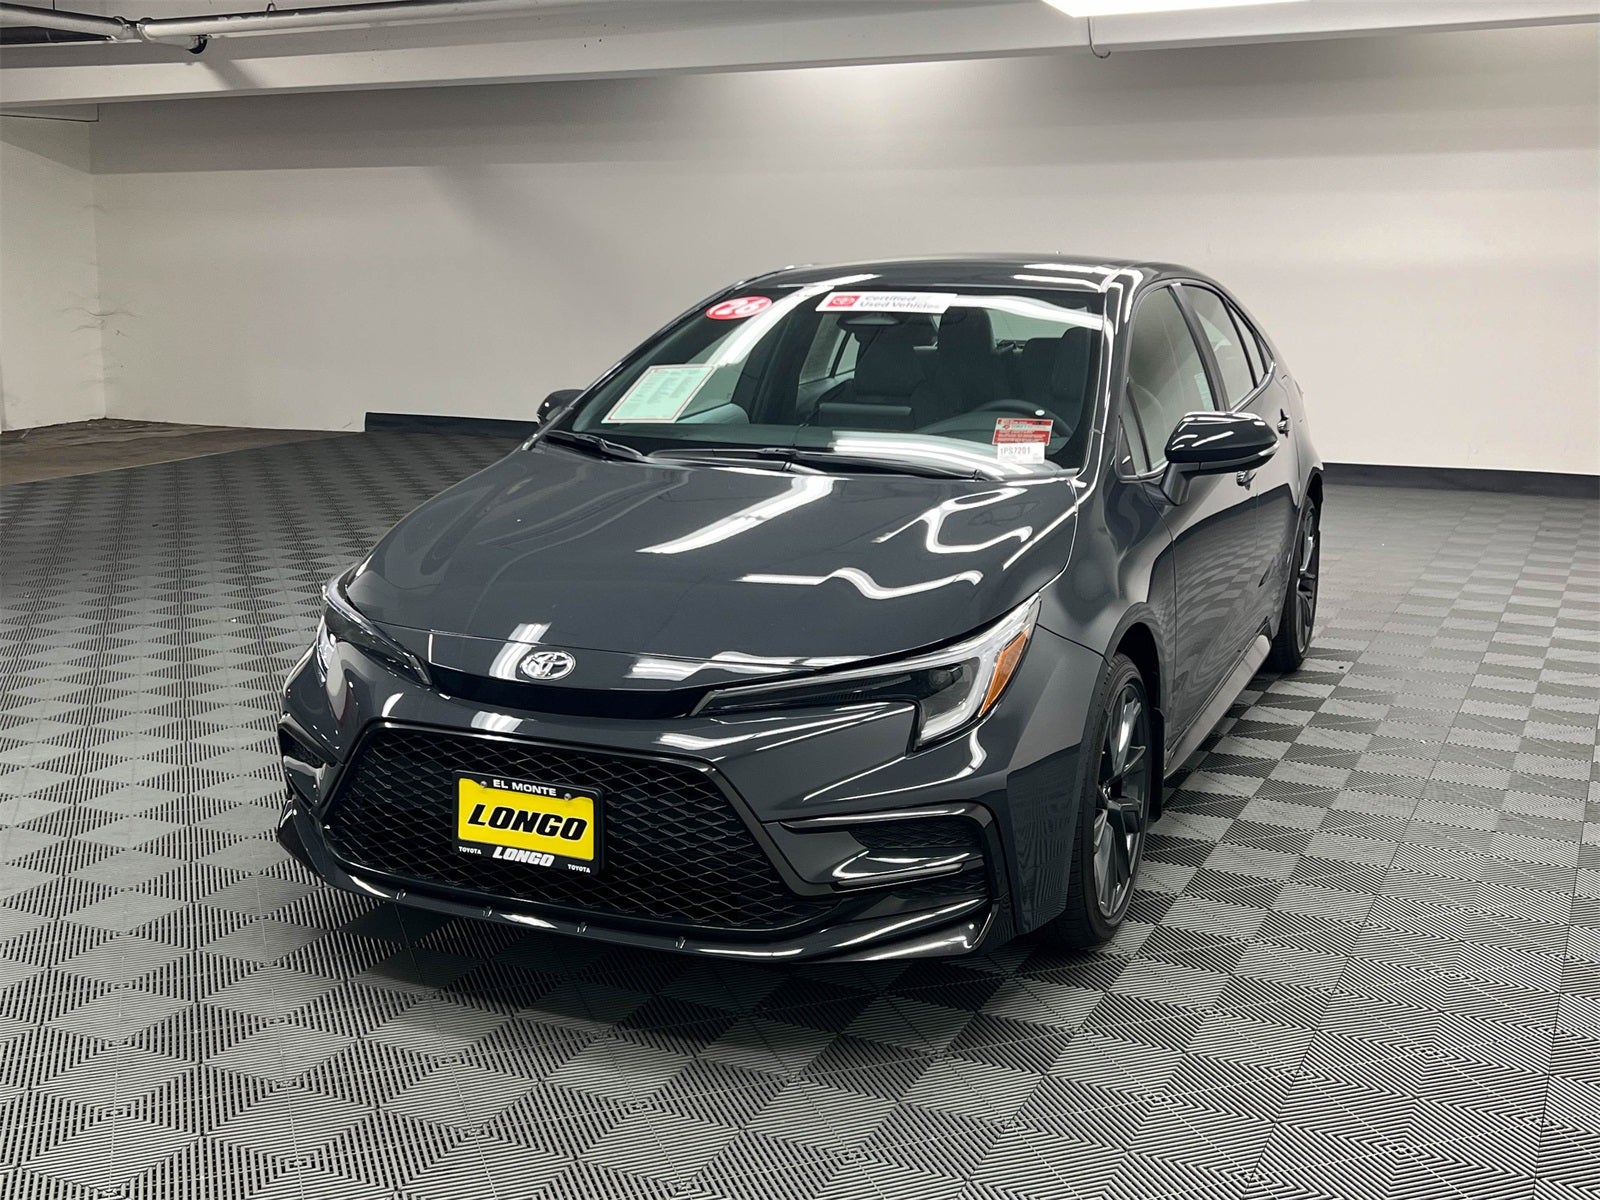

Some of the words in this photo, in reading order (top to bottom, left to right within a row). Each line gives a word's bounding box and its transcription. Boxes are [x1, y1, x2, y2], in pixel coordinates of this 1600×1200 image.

[1000, 446, 1031, 455] 1PS7201
[492, 779, 509, 789] EL
[511, 782, 557, 797] MONTE
[467, 803, 588, 841] LONGO
[458, 846, 482, 855] TOYOTA
[492, 846, 555, 867] LONGO
[567, 863, 591, 874] TOYOTA
